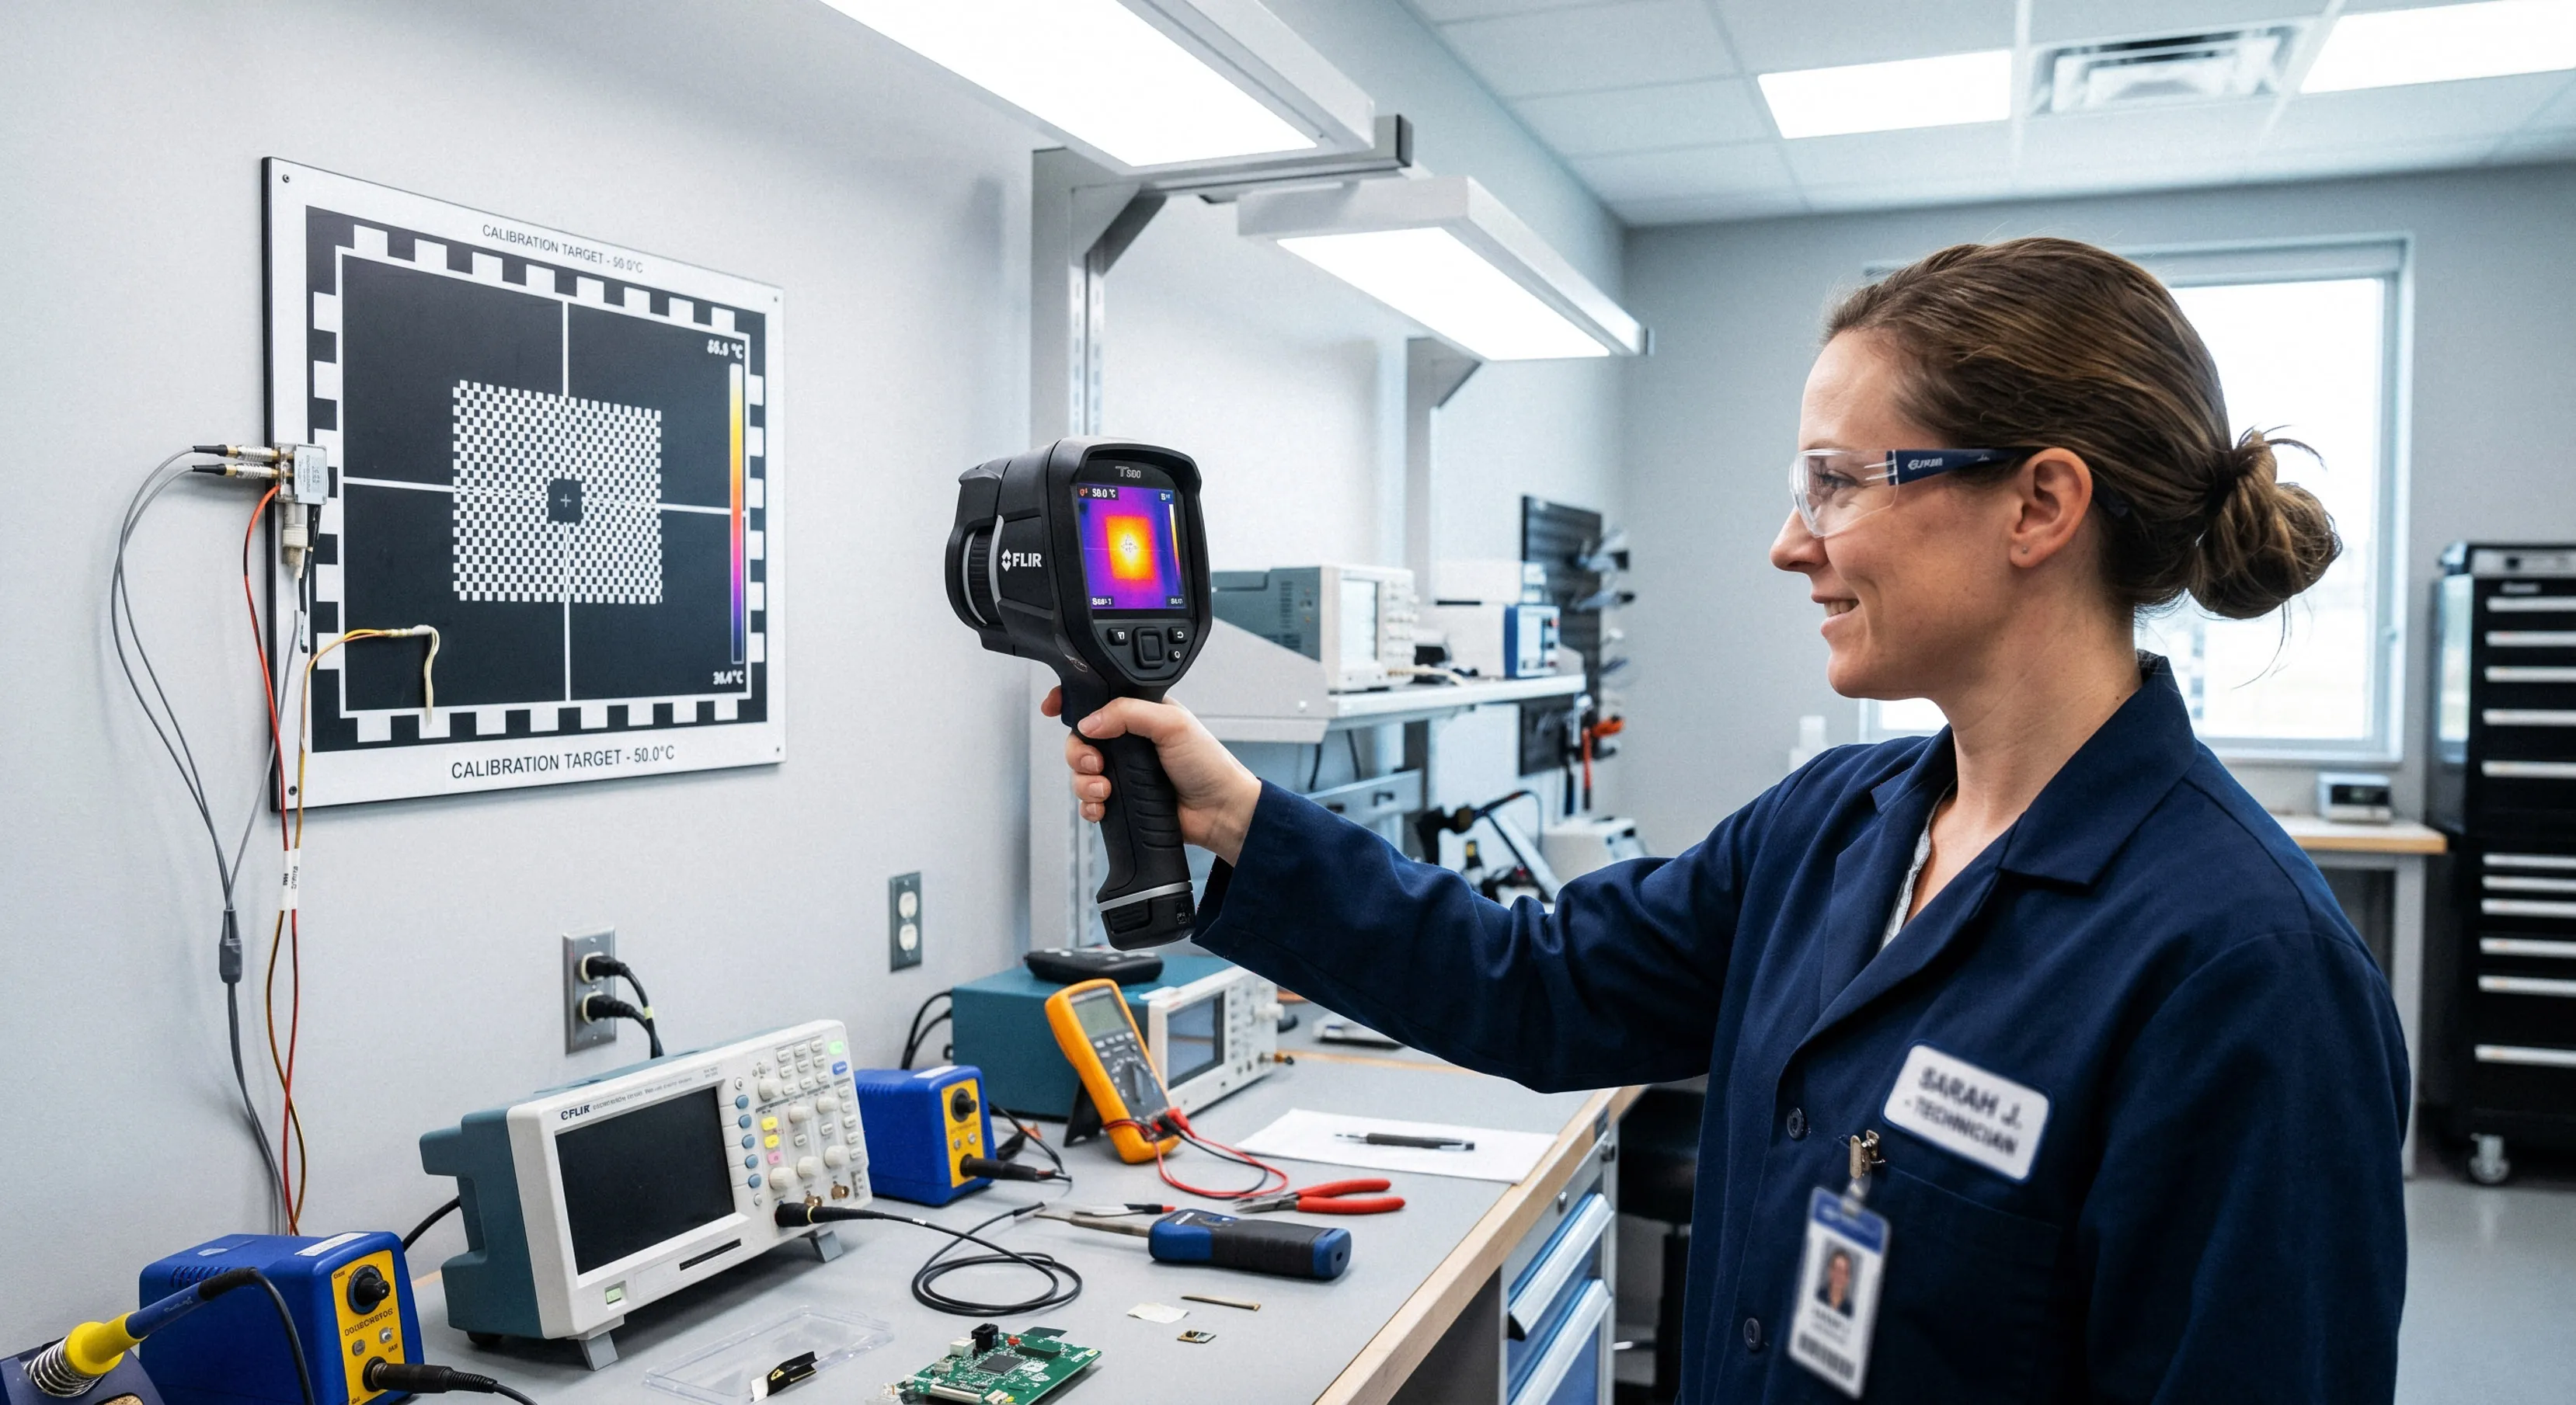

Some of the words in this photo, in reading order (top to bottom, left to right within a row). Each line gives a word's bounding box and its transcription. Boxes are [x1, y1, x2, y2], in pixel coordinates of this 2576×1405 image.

[482, 224, 559, 253] CALIBRATION
[562, 243, 603, 265] TARGET
[1012, 552, 1042, 567] FLIR
[451, 754, 559, 779] CALIBRATION
[565, 749, 622, 769] TARGET
[634, 745, 675, 763] 50.0°C
[1919, 1066, 2000, 1118] SARAH
[1915, 1095, 2018, 1156] TECHNICIAN
